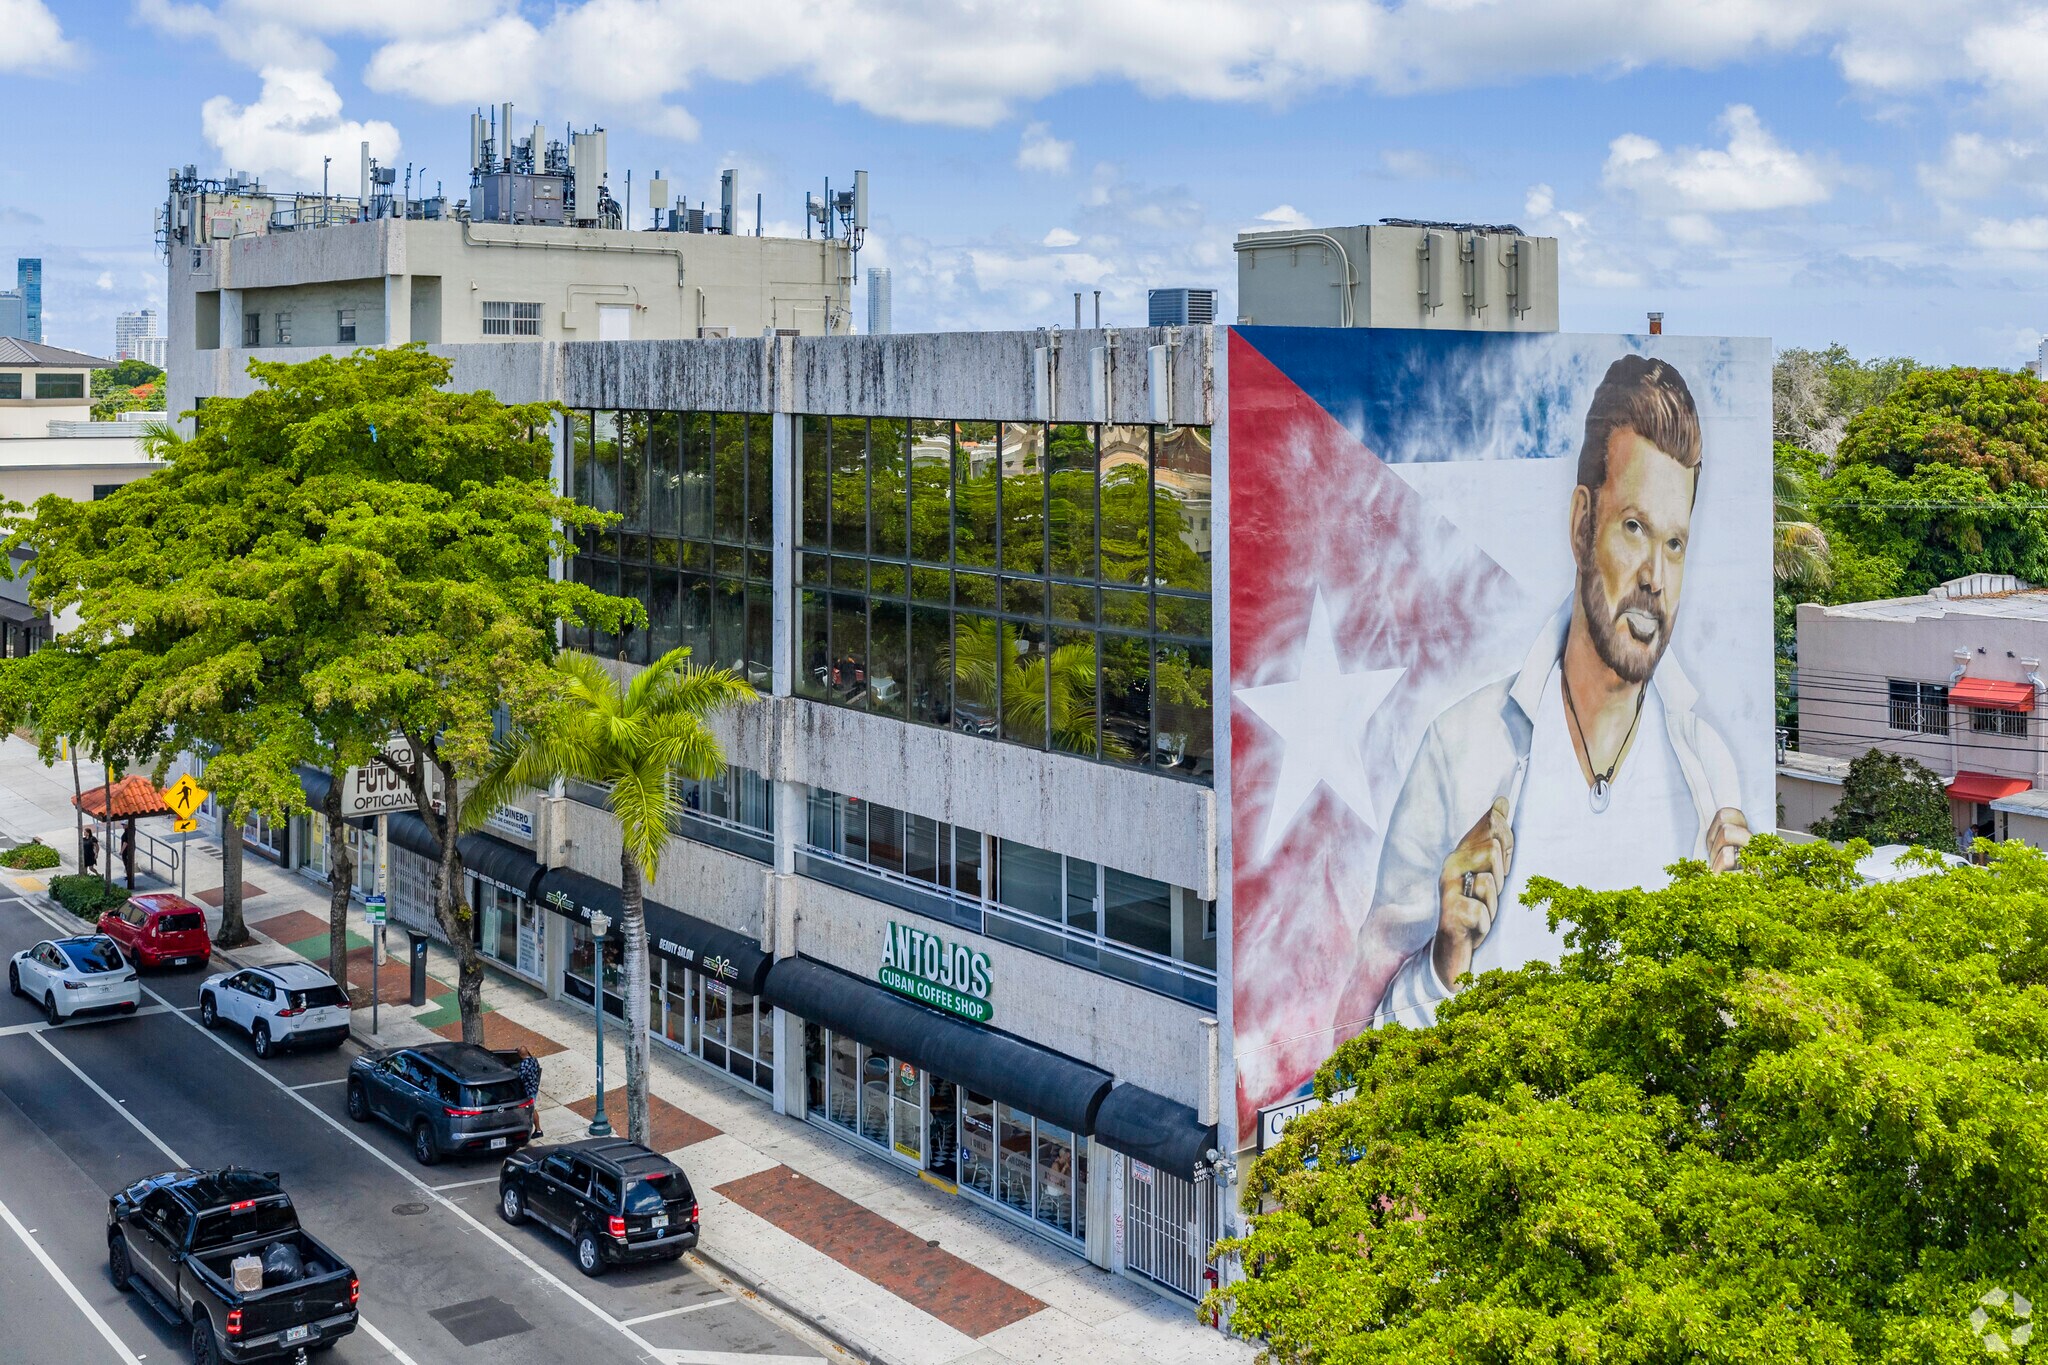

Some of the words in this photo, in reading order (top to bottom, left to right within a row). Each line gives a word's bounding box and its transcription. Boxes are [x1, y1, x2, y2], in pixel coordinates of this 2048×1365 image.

[504, 808, 529, 824] DINERO
[659, 938, 678, 955] BEAUTY
[677, 945, 695, 961] SALON
[881, 921, 990, 999] ANTOJOS
[881, 969, 915, 993] CUBAN
[917, 982, 953, 1009] COFFEE
[955, 997, 984, 1019] SHOP
